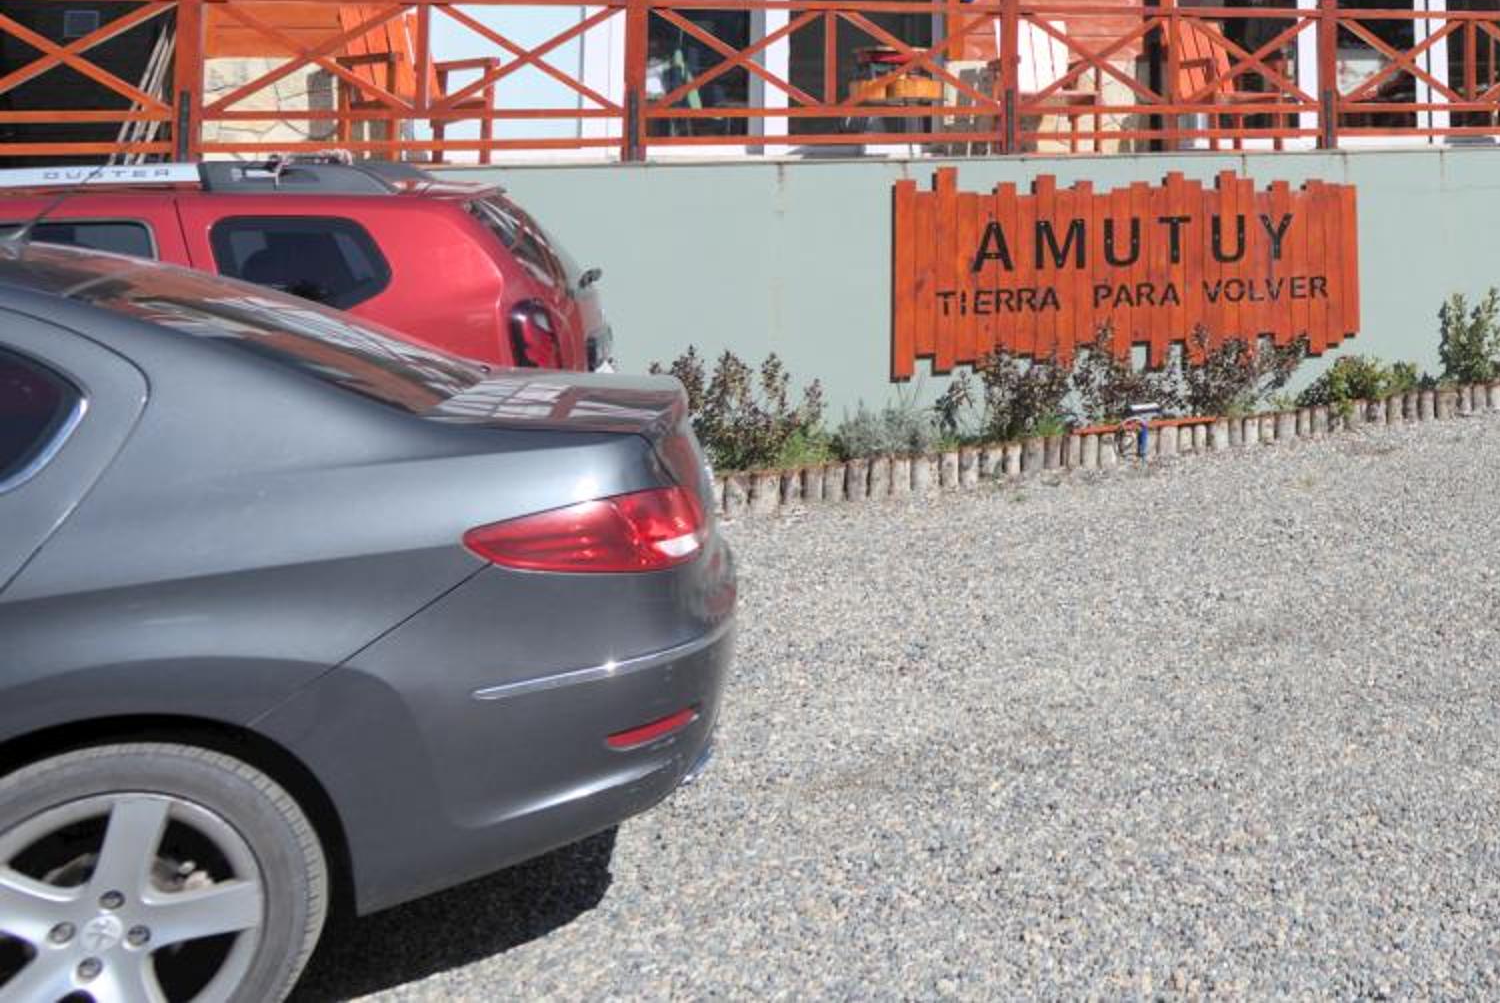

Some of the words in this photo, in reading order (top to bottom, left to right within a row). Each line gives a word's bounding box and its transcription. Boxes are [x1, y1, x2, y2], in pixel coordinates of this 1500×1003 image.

[971, 213, 1293, 272] AMUTUY
[935, 287, 1061, 316] TIERRA
[1093, 282, 1181, 309] PARA
[1203, 276, 1329, 304] VOLVER
